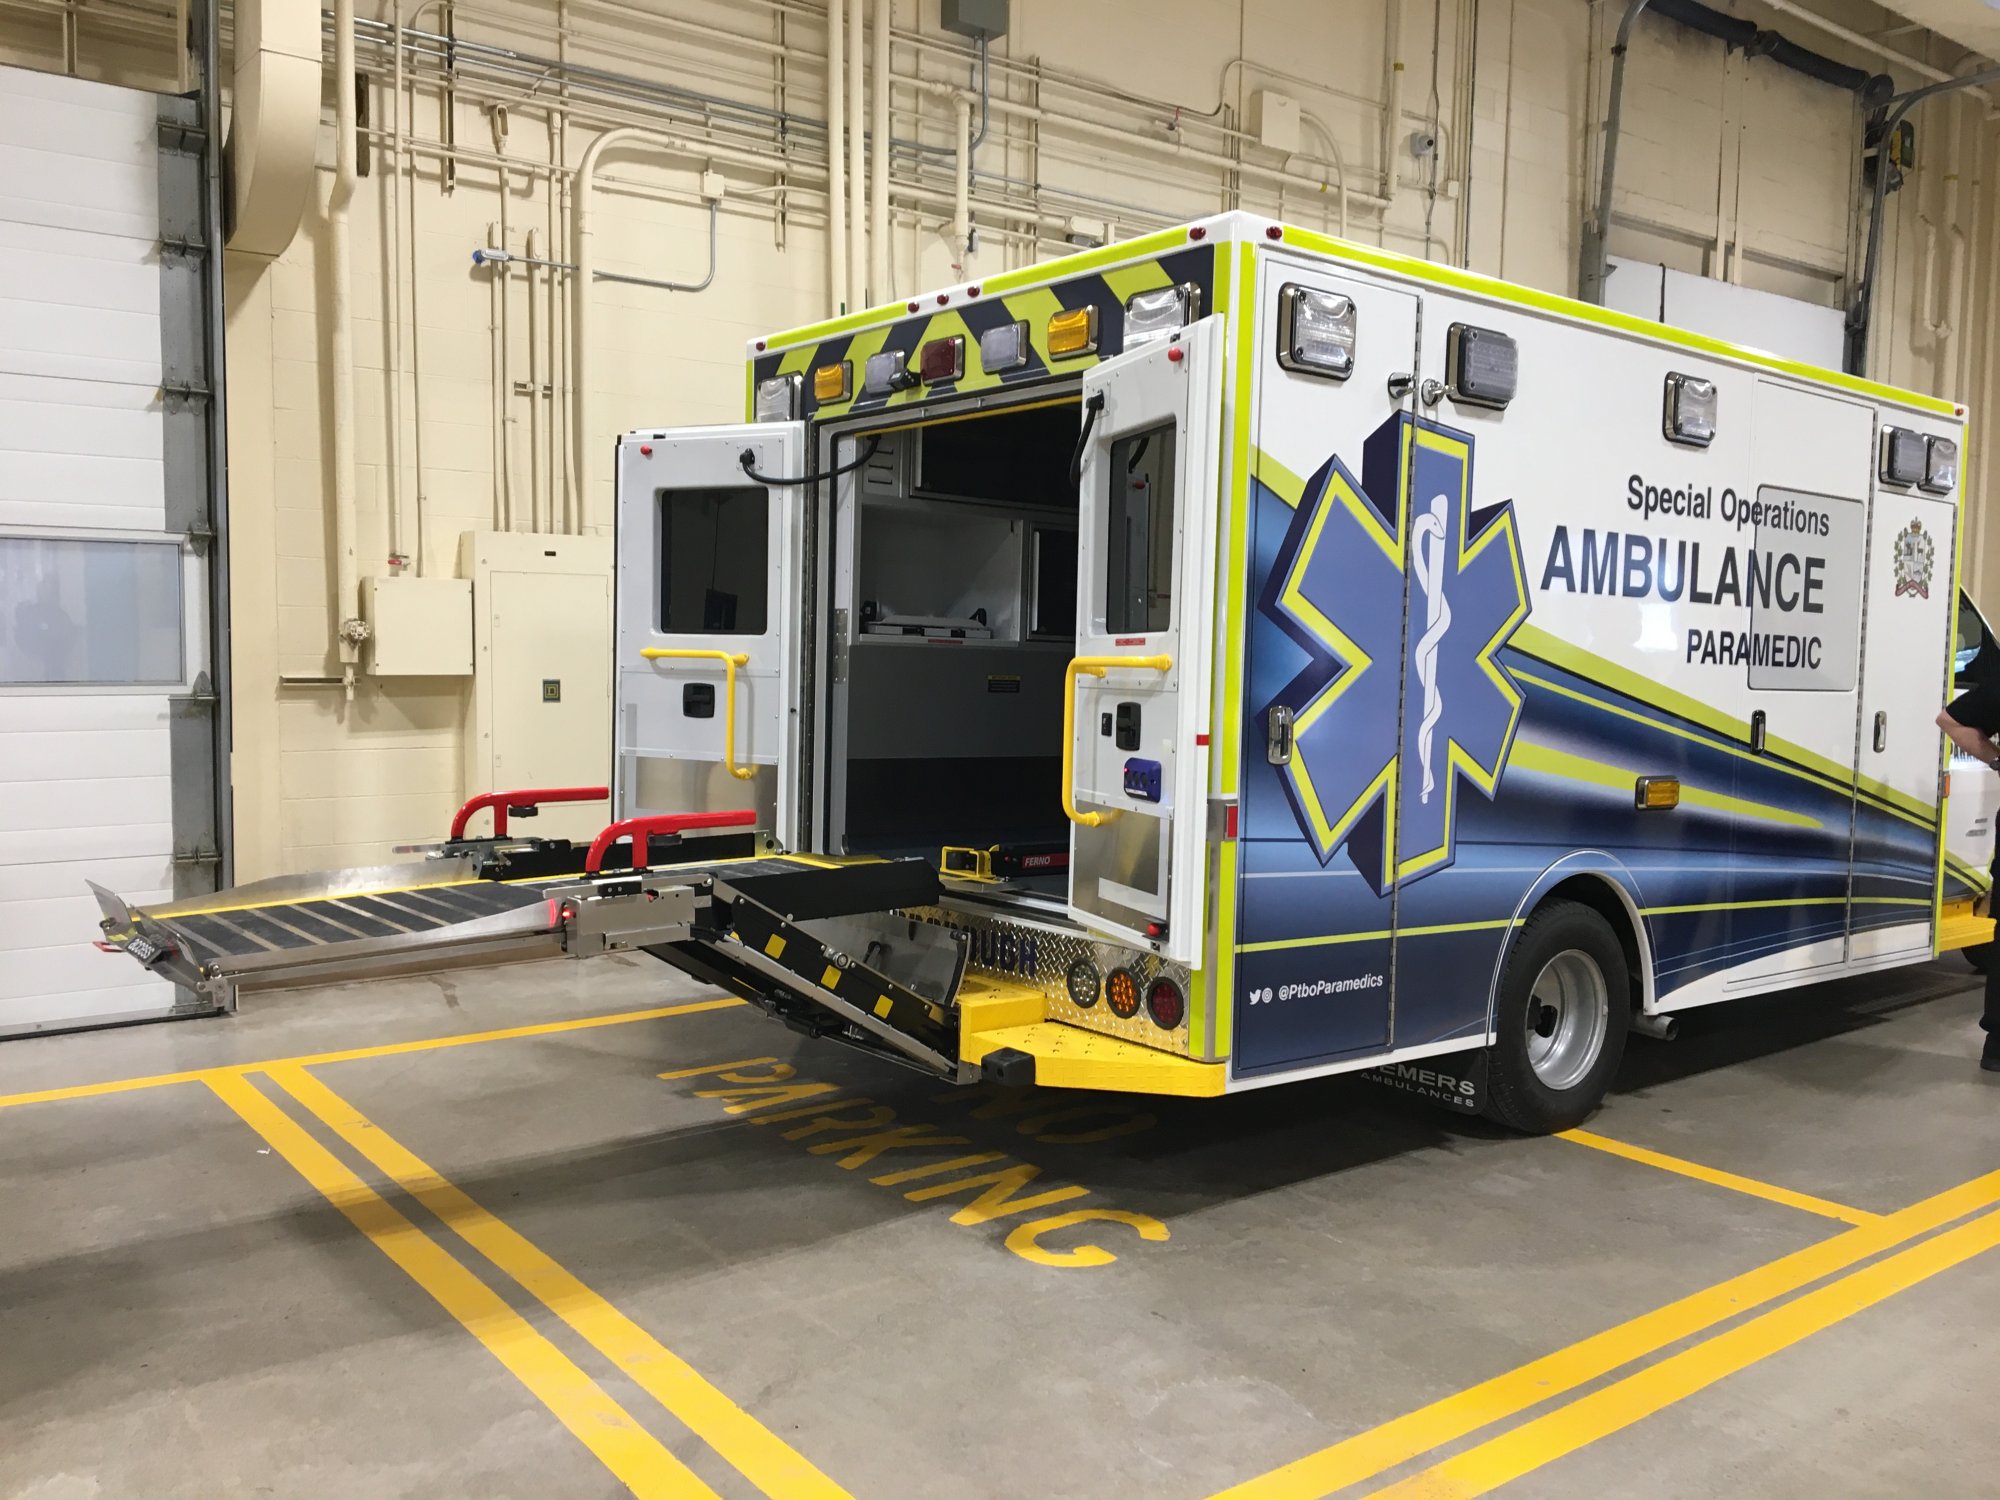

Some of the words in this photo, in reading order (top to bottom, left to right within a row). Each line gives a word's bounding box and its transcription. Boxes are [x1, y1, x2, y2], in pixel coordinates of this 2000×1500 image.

[1627, 473, 1712, 521] Special
[1720, 491, 1830, 537] Operations
[1540, 524, 1826, 614] AMBULANCE
[1686, 628, 1822, 670] PARAMEDIC
[1024, 855, 1051, 867] FERNO
[1278, 973, 1384, 1001] @PtboParamedics
[1360, 1071, 1475, 1108] AMBULANCES
[1368, 1063, 1476, 1096] EMERS
[656, 1056, 1172, 1268] PARKING
